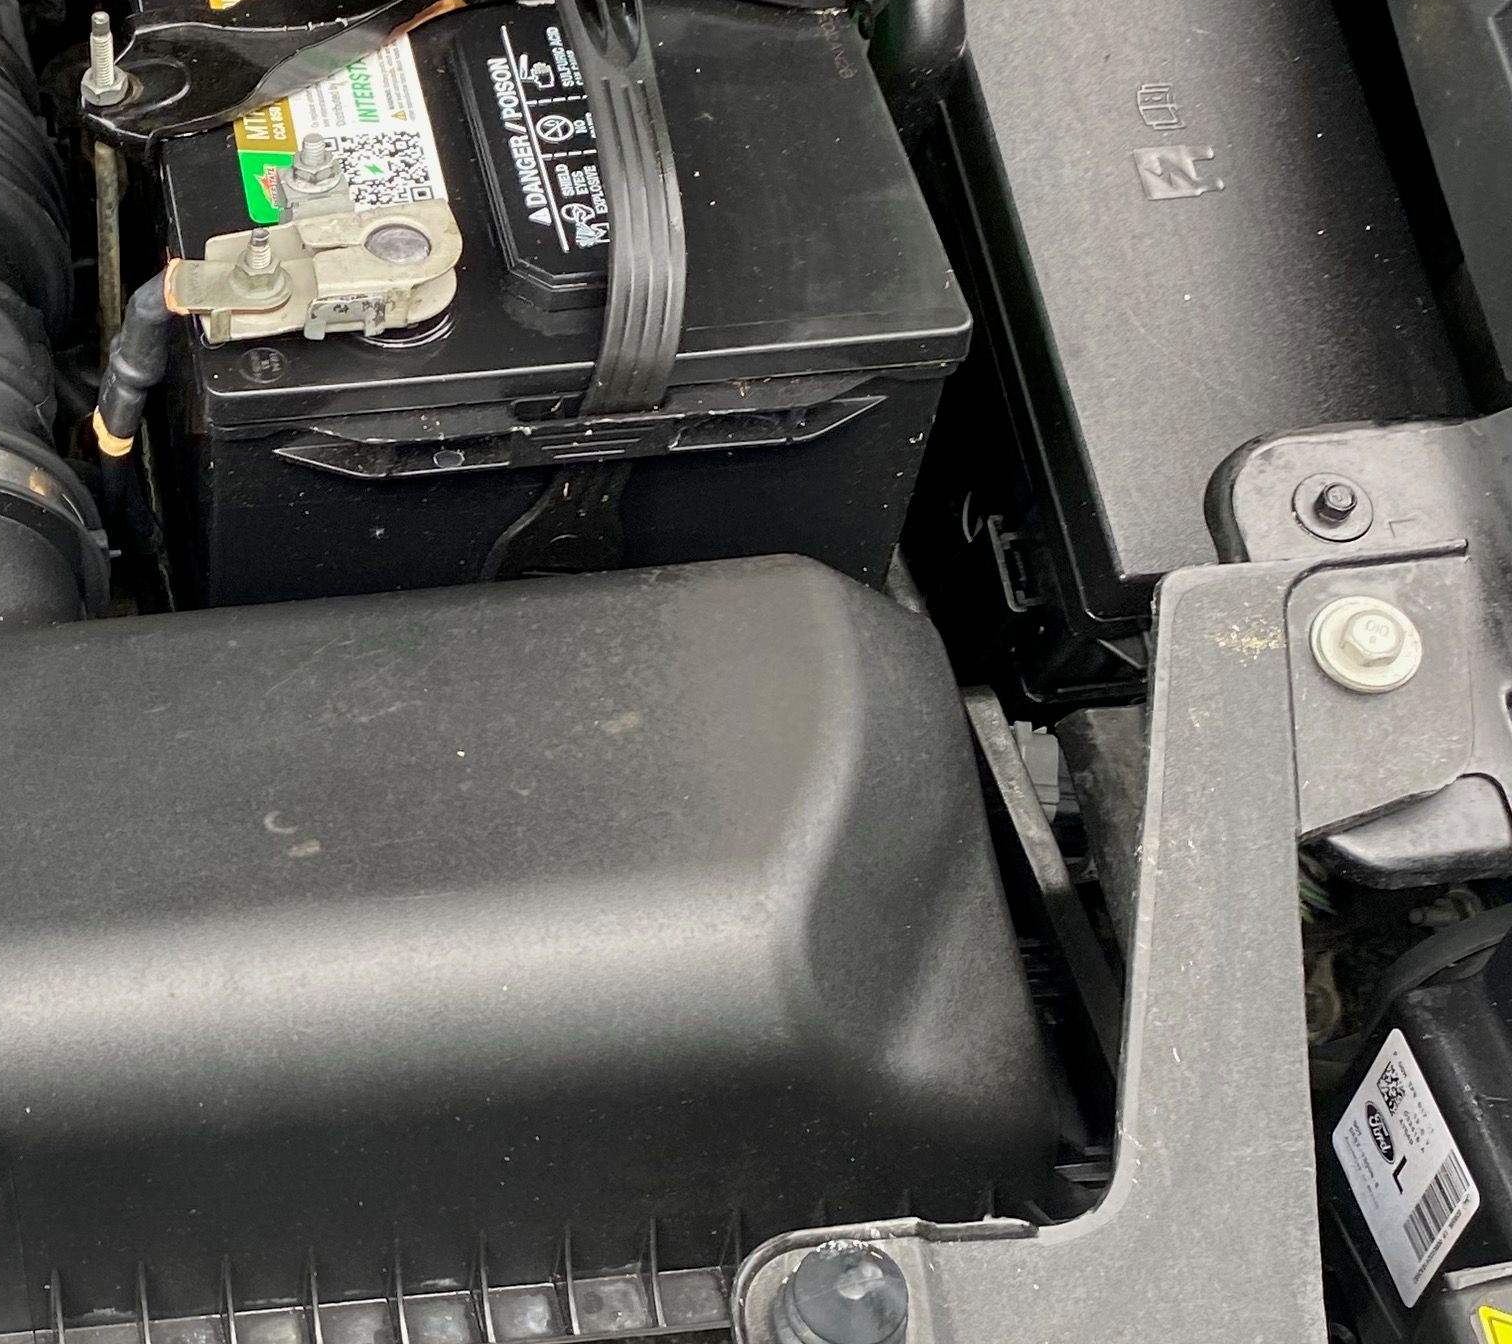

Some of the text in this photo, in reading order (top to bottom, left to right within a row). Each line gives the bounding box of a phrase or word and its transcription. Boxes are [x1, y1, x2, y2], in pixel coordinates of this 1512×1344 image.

[546, 26, 575, 87] SULFURIC ACID
[269, 107, 286, 140] CCA 850
[574, 120, 587, 133] NO
[555, 164, 575, 197] SHIELD
[571, 170, 589, 196] EYES
[583, 165, 608, 215] EXPLOSIVE
